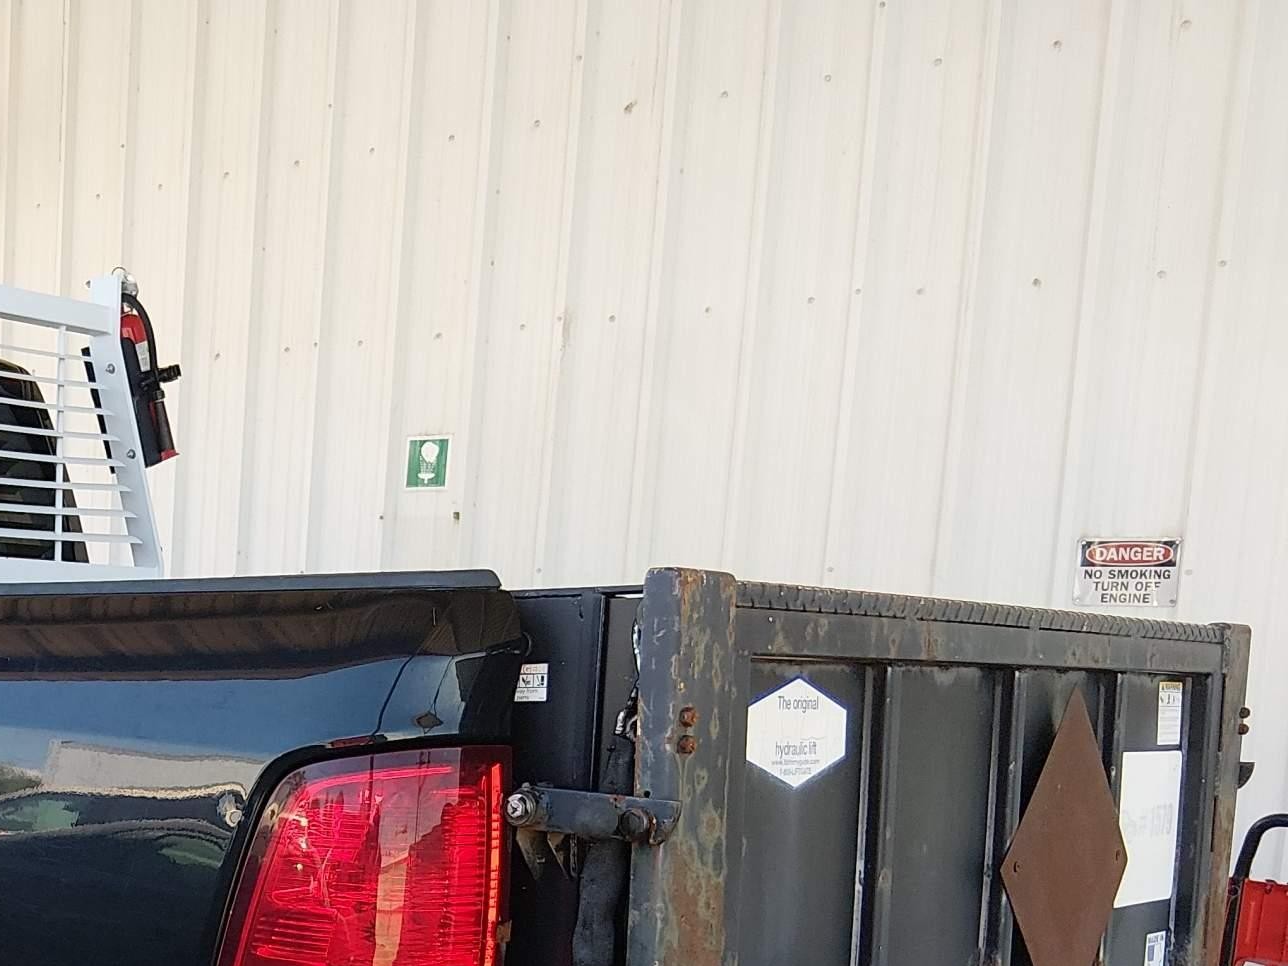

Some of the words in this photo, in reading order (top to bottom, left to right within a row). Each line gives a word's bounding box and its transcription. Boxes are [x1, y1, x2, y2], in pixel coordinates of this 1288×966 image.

[1095, 547, 1165, 561] DANGER
[1083, 569, 1103, 580] NO
[1108, 569, 1171, 580] SMOKING
[1094, 581, 1129, 592] TURN
[1135, 581, 1161, 592] OFF
[1100, 593, 1150, 604] ENGINE
[778, 695, 792, 710] The
[793, 696, 819, 713] original
[775, 741, 808, 759] hydraulic
[808, 741, 817, 755] lift
